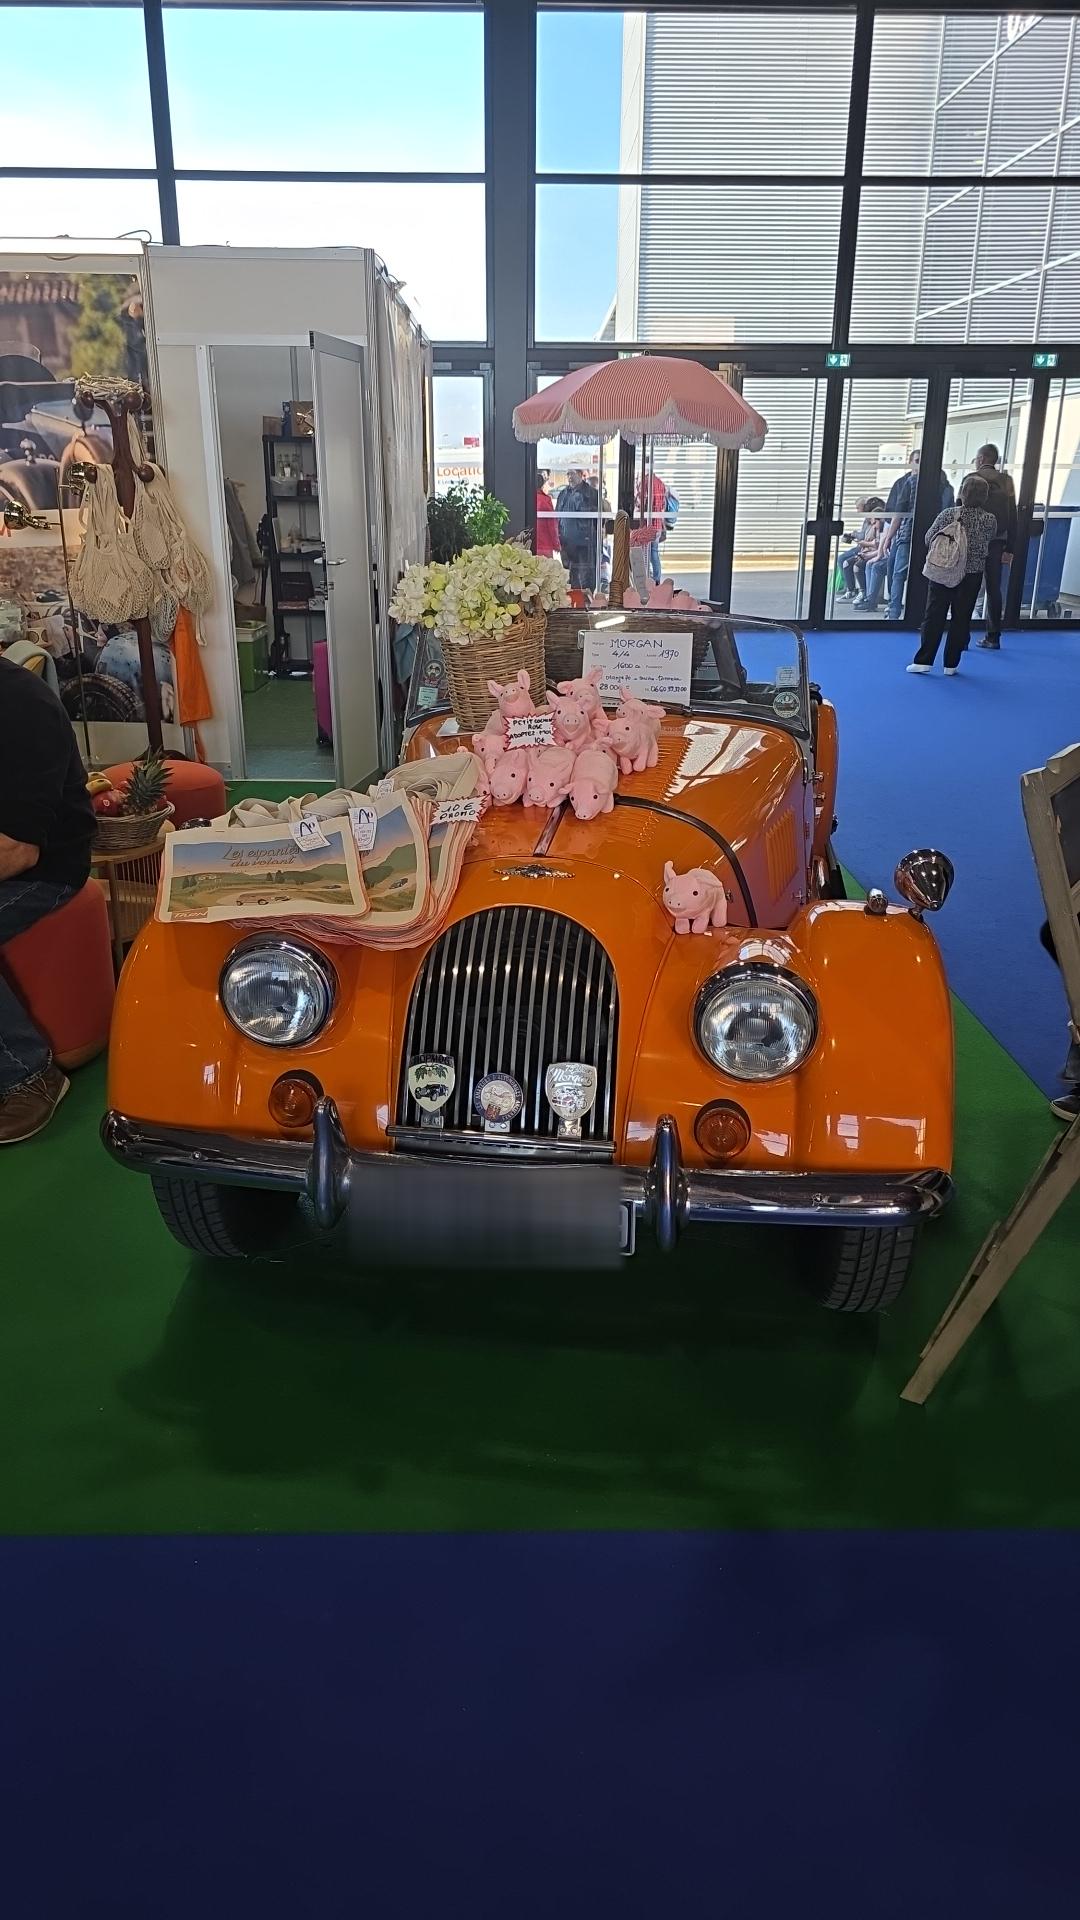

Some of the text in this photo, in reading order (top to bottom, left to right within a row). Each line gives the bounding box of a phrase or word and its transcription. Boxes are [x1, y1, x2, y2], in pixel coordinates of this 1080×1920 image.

[610, 639, 663, 648] MORGAN
[612, 650, 630, 658] 4/4
[659, 649, 679, 660] 1970
[440, 810, 476, 820] PROMO
